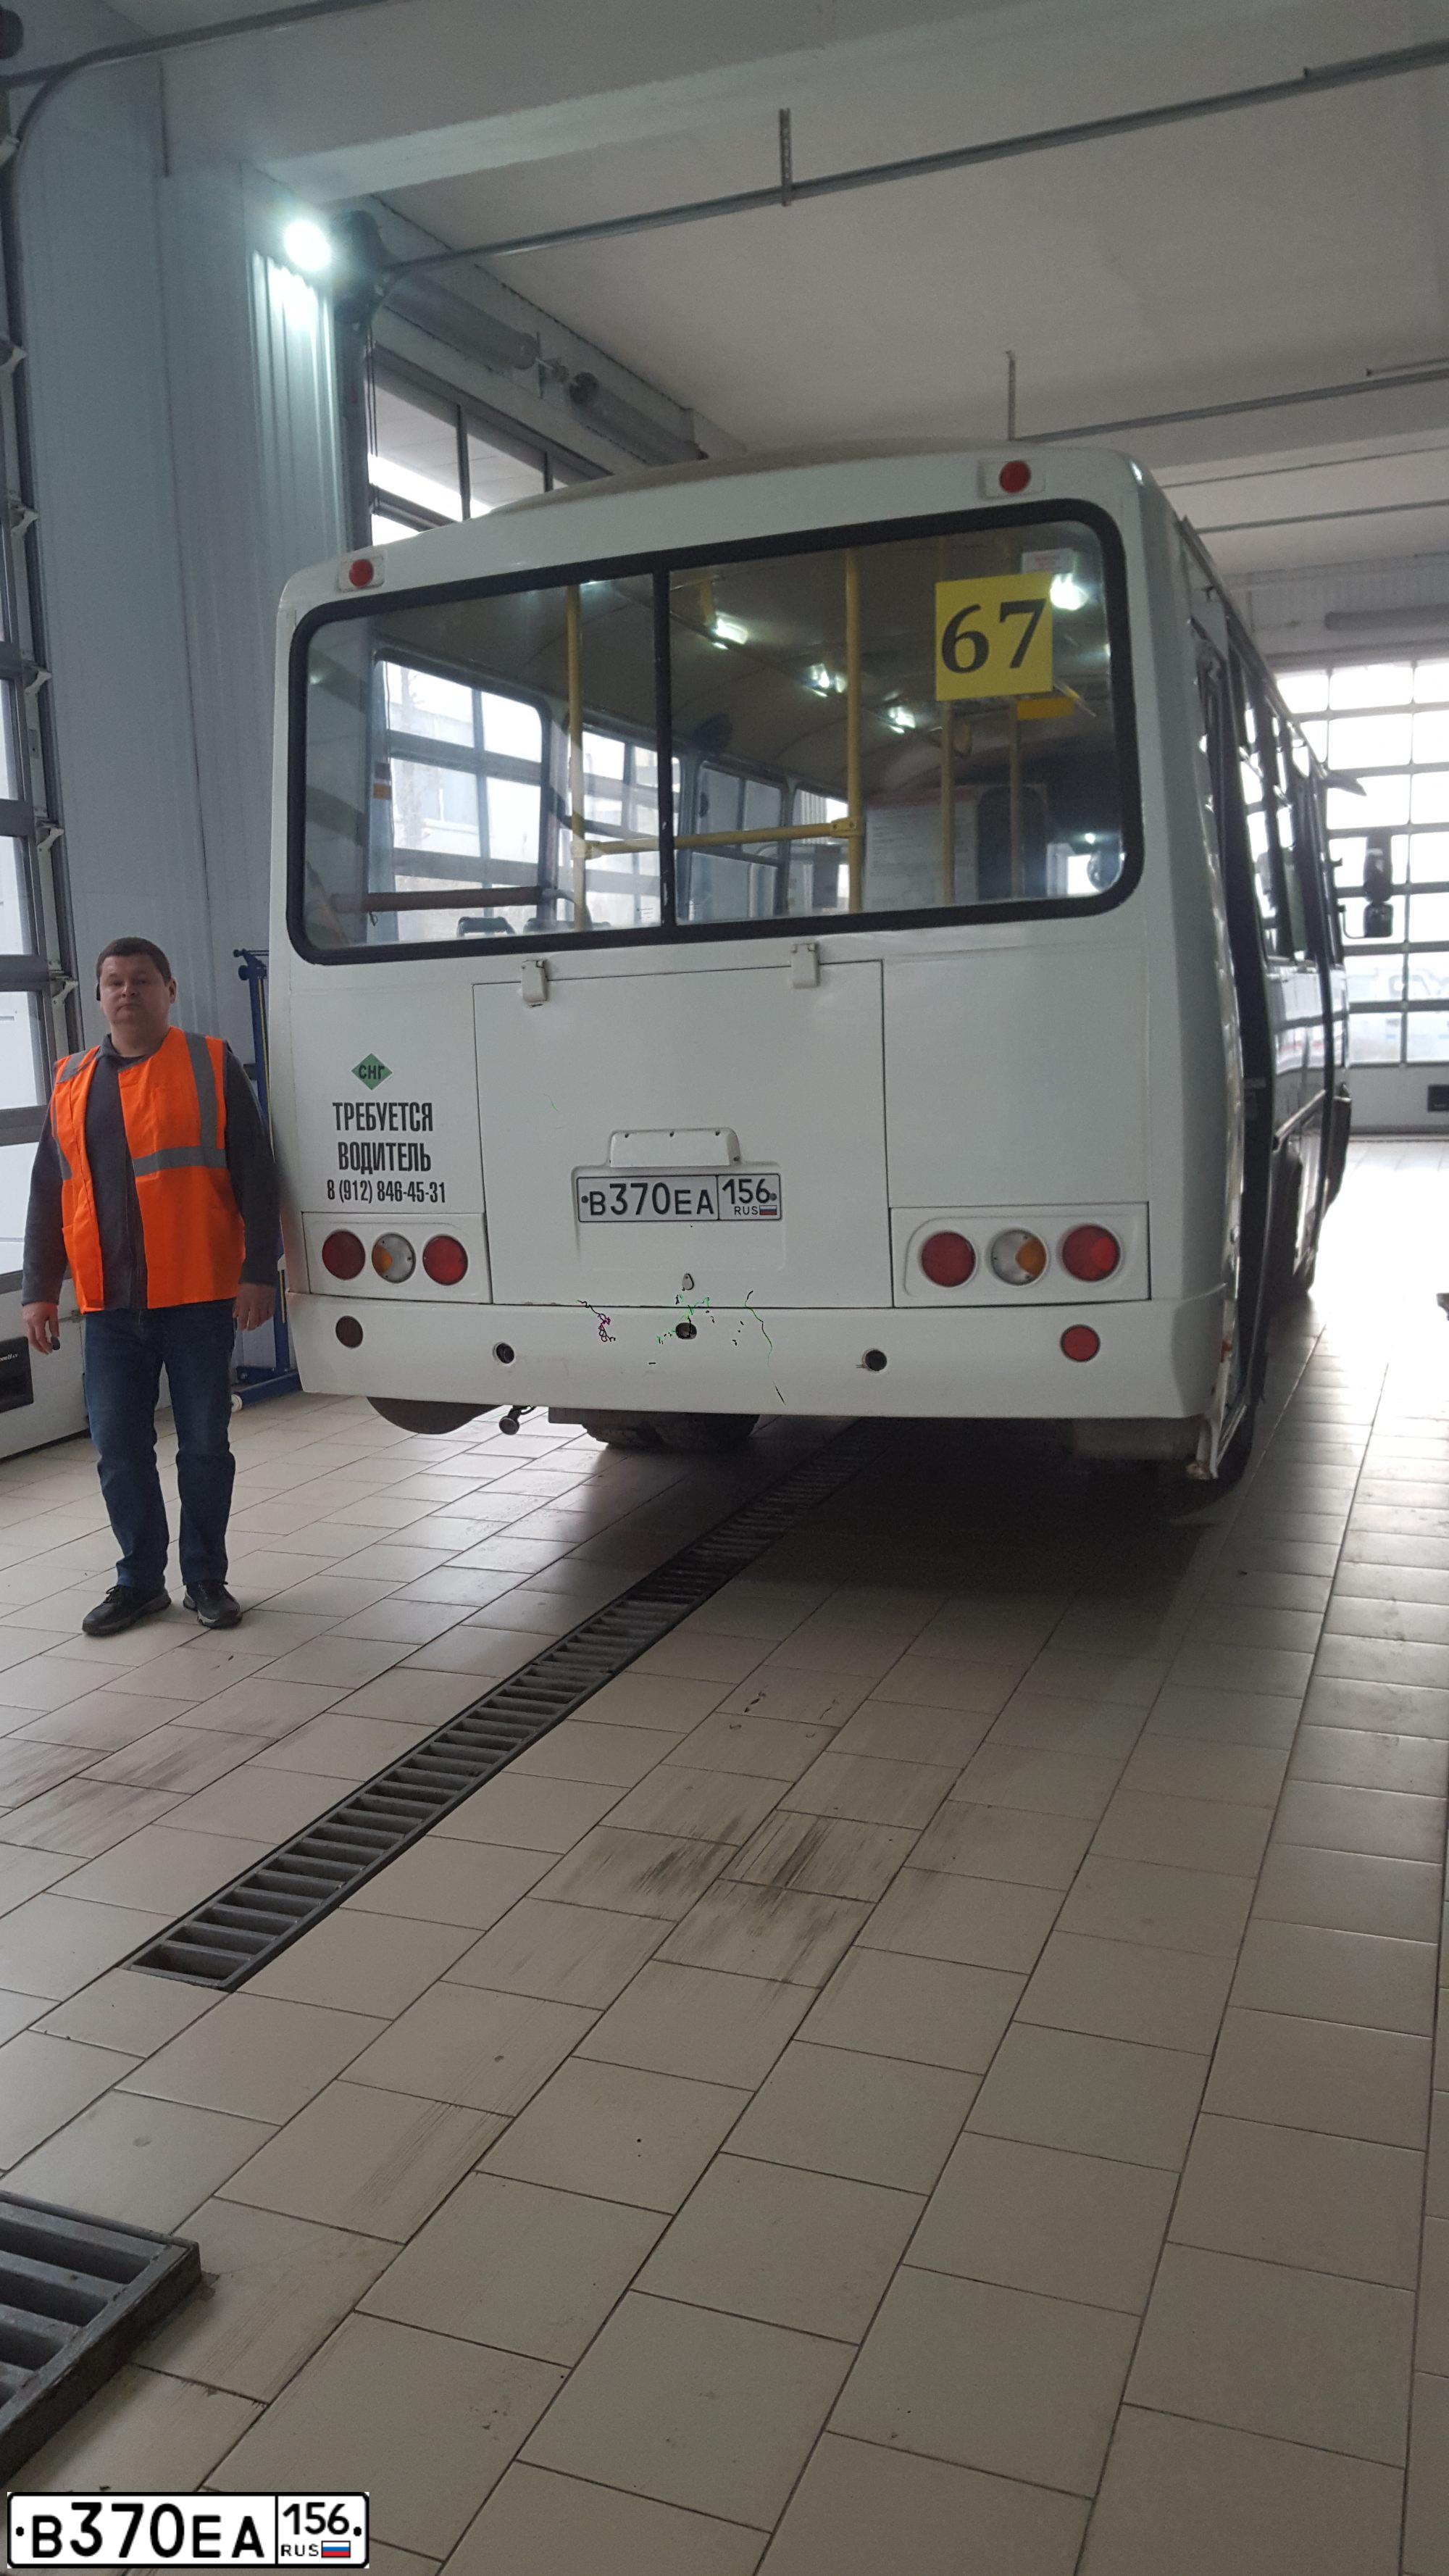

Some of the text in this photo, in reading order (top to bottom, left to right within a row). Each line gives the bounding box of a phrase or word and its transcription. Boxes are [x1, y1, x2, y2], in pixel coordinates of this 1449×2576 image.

[941, 599, 1046, 673] 67
[359, 1065, 385, 1080] СНГ
[332, 1102, 433, 1132] ТРЕБУЕТСЯ
[338, 1141, 432, 1175] ВОДИТЕЛЬ
[327, 1180, 446, 1204] 8 (912) 846-45-31
[722, 1178, 770, 1204] 156
[735, 1206, 758, 1215] RUS
